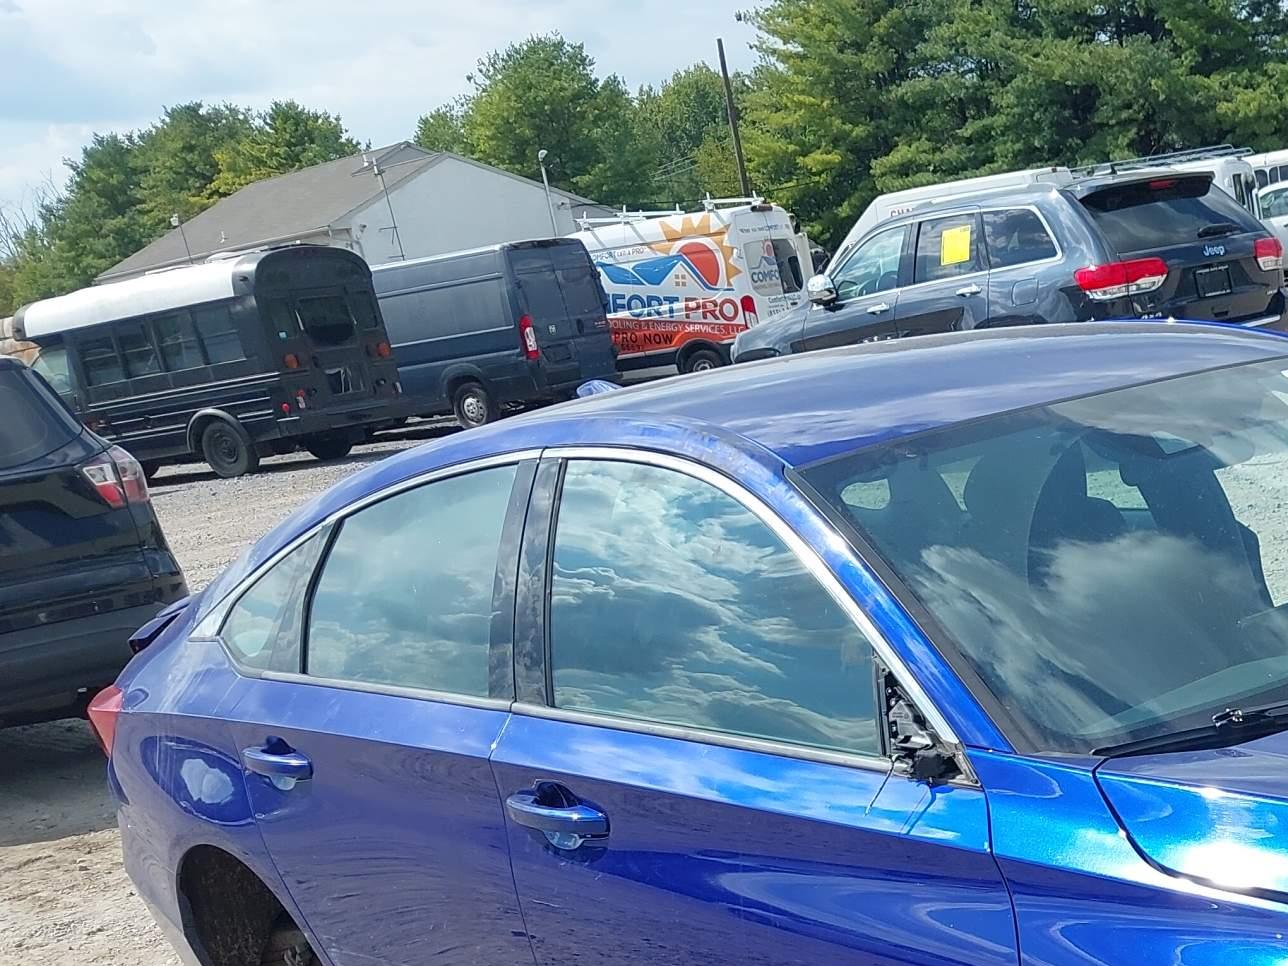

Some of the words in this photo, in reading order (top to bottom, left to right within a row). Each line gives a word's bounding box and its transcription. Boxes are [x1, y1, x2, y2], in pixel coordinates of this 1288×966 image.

[1203, 245, 1225, 256] Jeep
[684, 296, 739, 322] PRO
[649, 321, 683, 333] ENERGY
[614, 331, 638, 344] PRO
[643, 333, 673, 345] NOW
